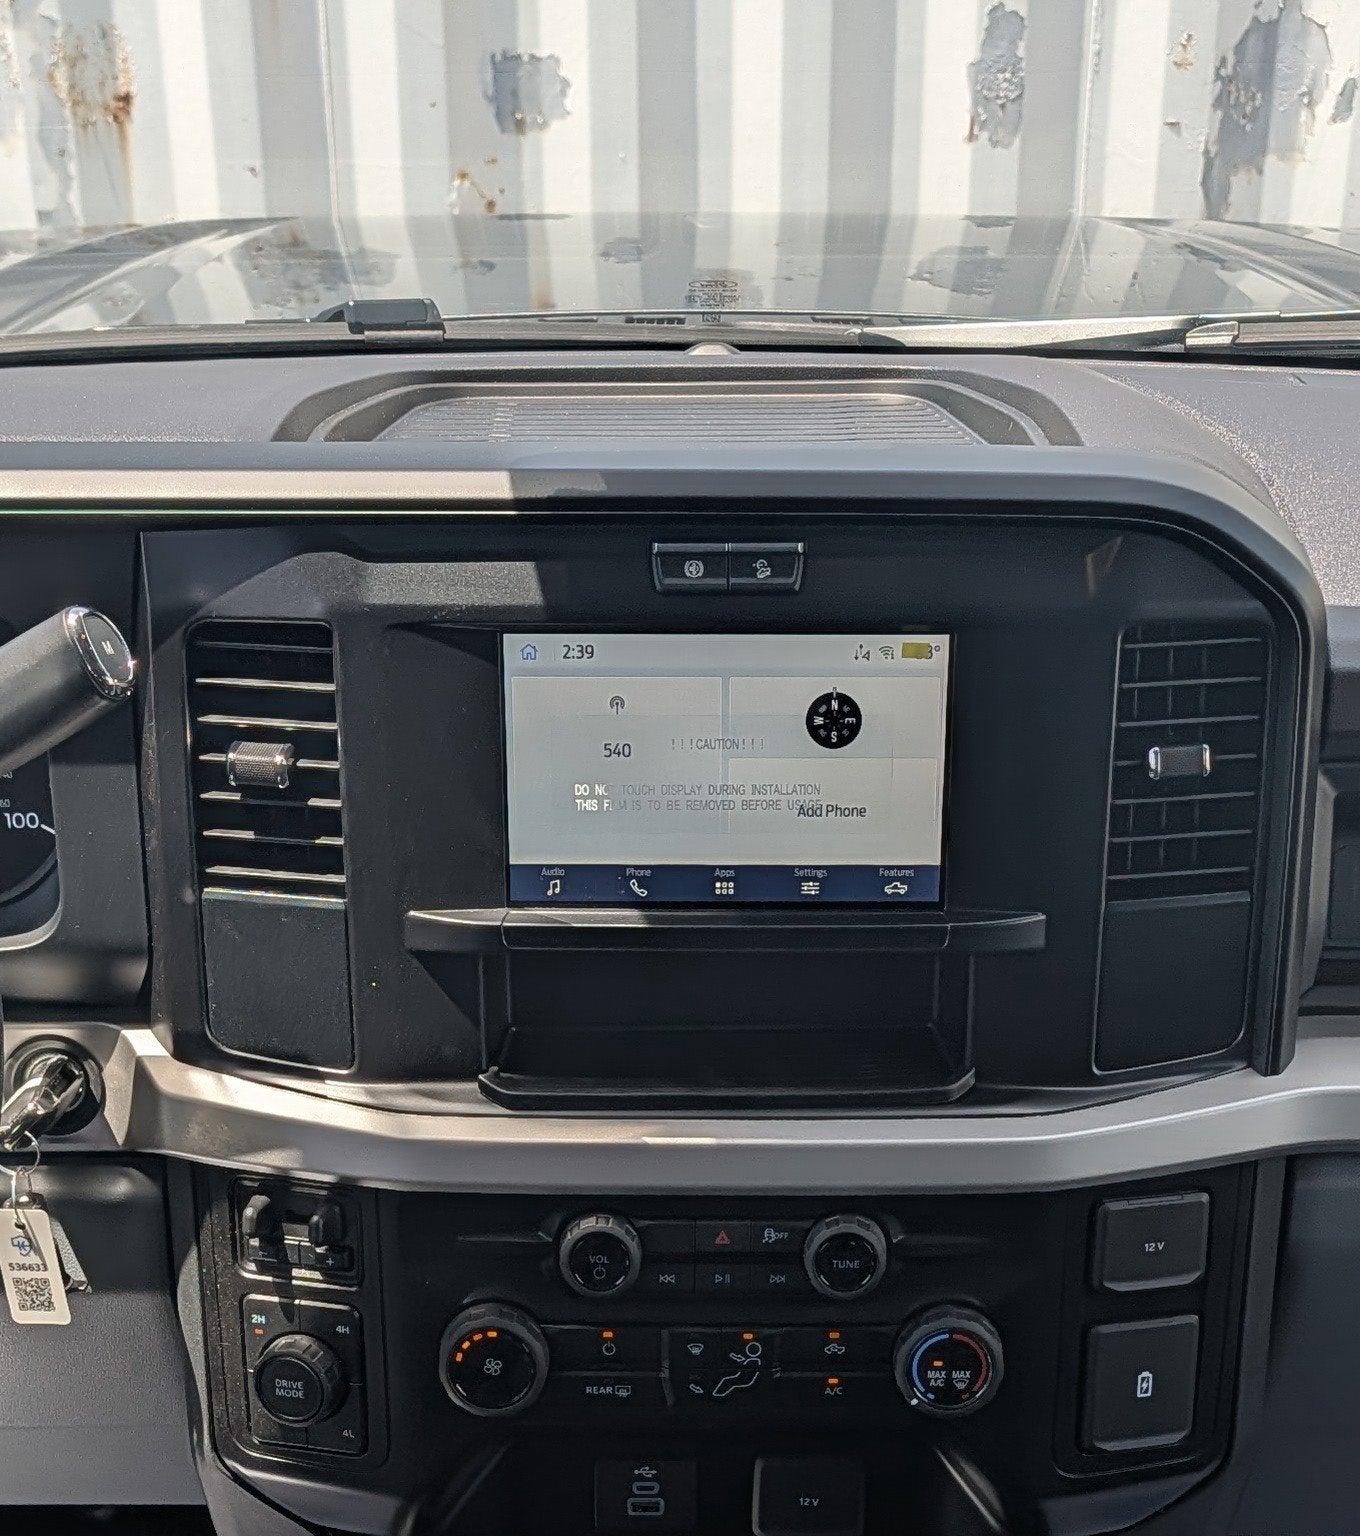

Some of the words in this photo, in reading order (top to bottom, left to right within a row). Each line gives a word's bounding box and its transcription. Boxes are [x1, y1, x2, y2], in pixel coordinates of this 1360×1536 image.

[562, 644, 594, 660] 2:39
[831, 700, 838, 710] N
[813, 716, 824, 726] W
[830, 732, 838, 743] S
[604, 743, 632, 758] 540
[574, 784, 590, 796] DO
[622, 785, 656, 796] TOUCH
[661, 785, 702, 796] DISPLAY
[708, 784, 746, 796] DURING
[575, 800, 598, 812] THIS
[603, 800, 629, 811] FIM
[648, 800, 660, 811] TO
[667, 800, 681, 811] BE
[686, 800, 736, 811] REMOVED
[741, 800, 782, 810] BEFORE
[797, 804, 823, 818] Add
[826, 804, 867, 818] Phone
[3, 812, 39, 829] 100
[540, 868, 565, 877] Audio
[626, 868, 652, 877] Phone
[714, 868, 736, 879] Apps
[794, 868, 828, 879] Settings
[879, 868, 915, 877] Features
[590, 1255, 610, 1264] VOL
[832, 1260, 860, 1268] TUNE
[251, 1314, 266, 1324] 2H
[336, 1325, 350, 1334] 4H
[928, 1370, 946, 1378] MAX
[952, 1370, 971, 1378] MAX
[275, 1378, 304, 1390] DRIVE
[276, 1388, 304, 1398] MODE
[586, 1386, 613, 1394] REAR
[824, 1387, 843, 1396] A/C
[342, 1429, 355, 1439] 4L
